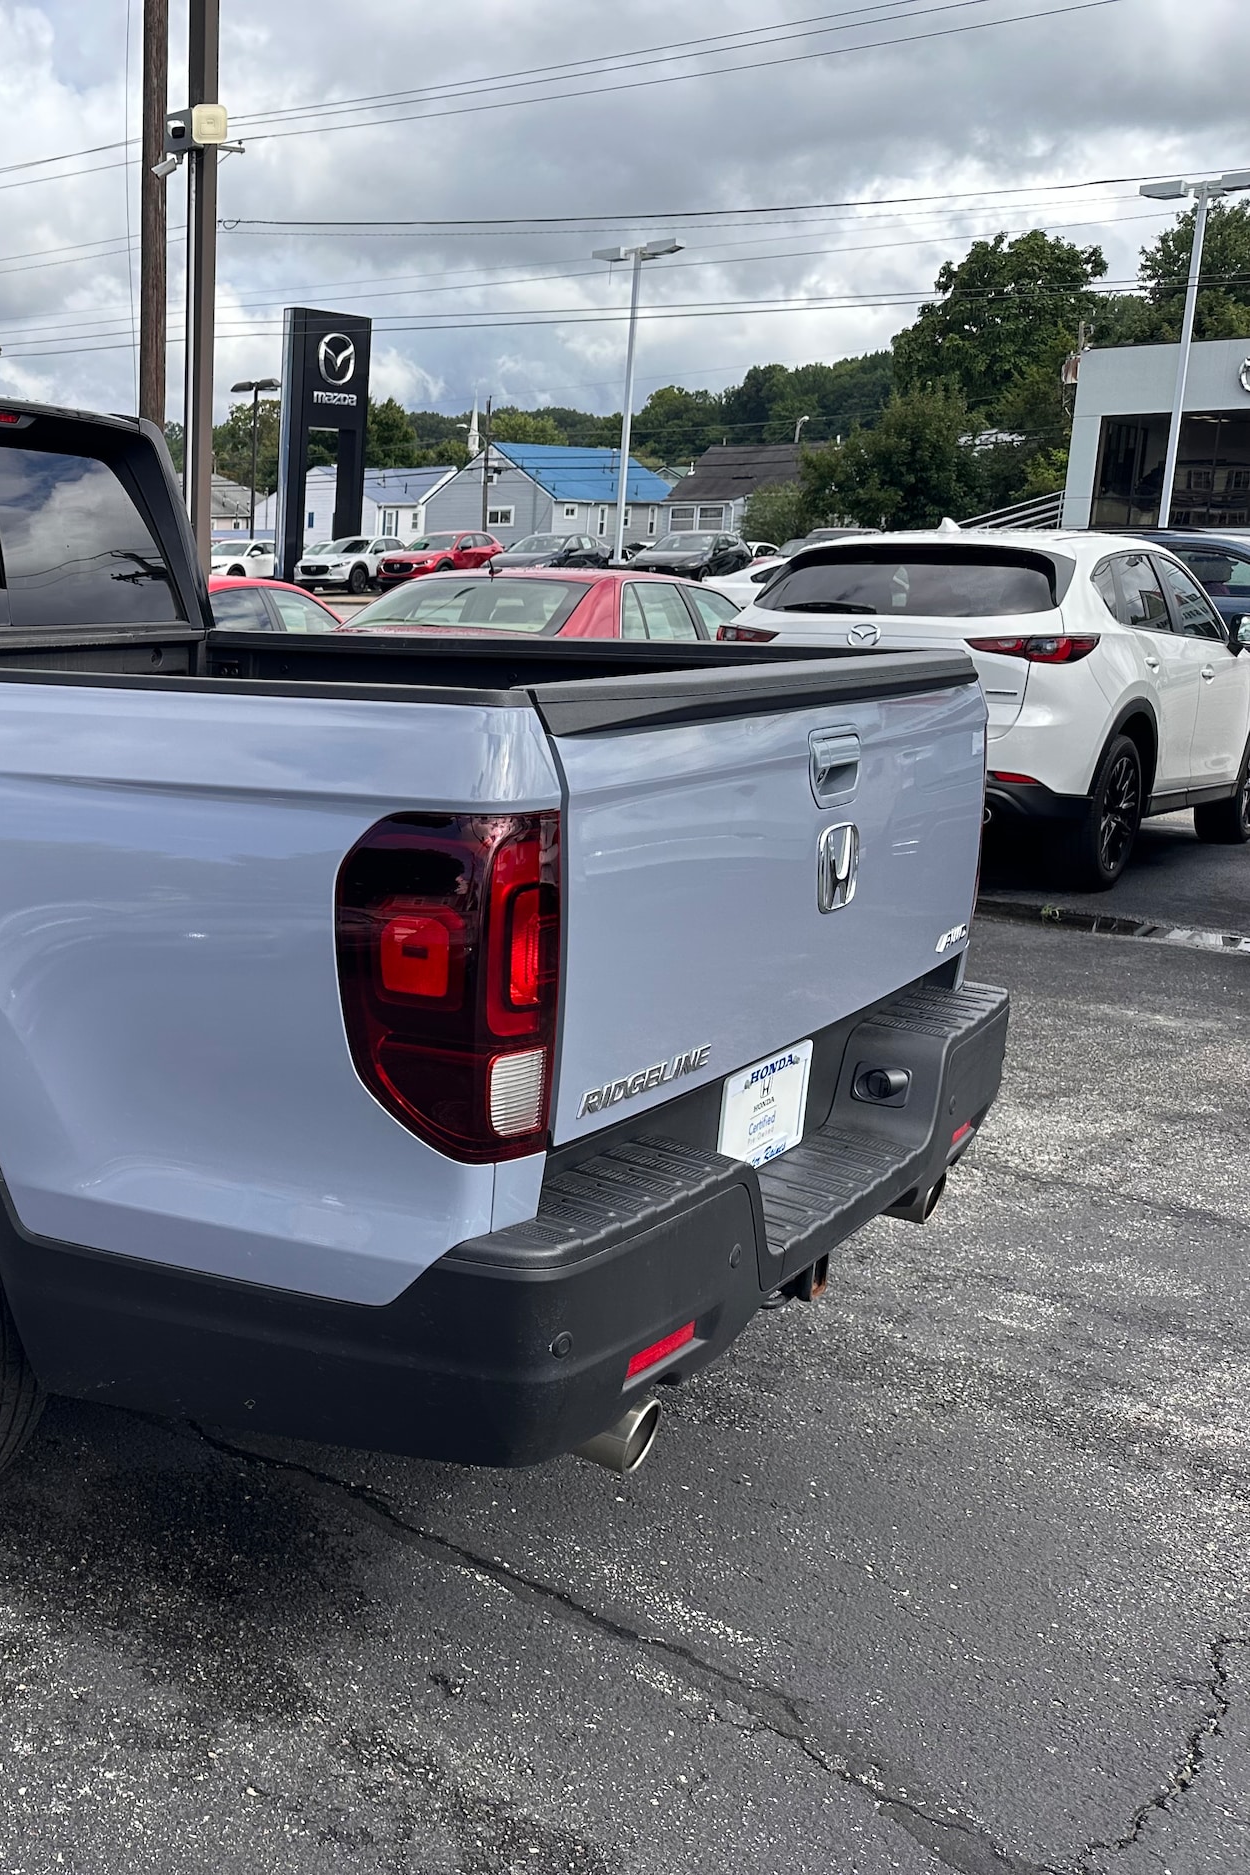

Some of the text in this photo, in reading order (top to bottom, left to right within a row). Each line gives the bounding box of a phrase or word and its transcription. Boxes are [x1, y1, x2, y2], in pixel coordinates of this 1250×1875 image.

[313, 390, 357, 406] mazda
[576, 1043, 712, 1120] RIDGELINE
[750, 1053, 794, 1086] HONDA
[753, 1096, 775, 1113] HONDA
[748, 1110, 777, 1136] Certified
